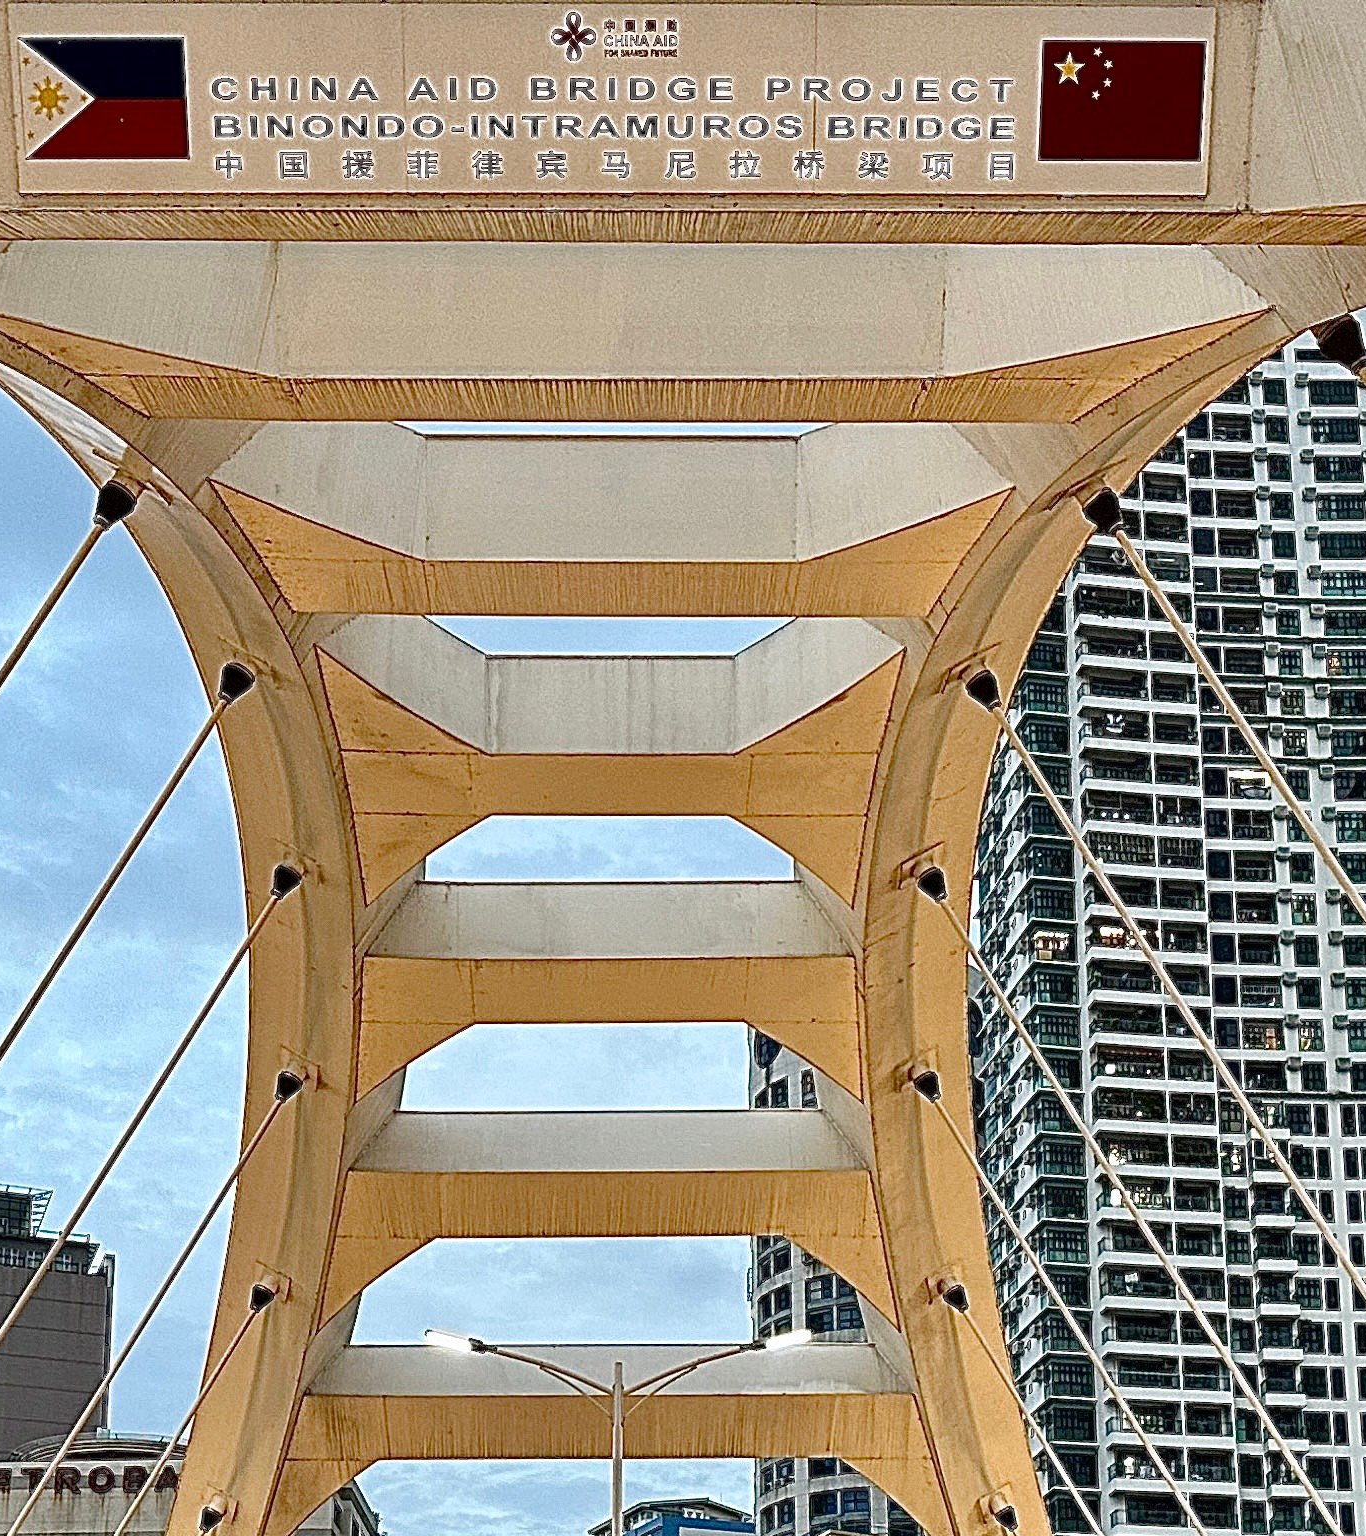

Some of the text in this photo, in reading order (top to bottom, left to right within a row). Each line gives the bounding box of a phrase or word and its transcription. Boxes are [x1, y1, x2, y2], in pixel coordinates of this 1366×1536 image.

[603, 34, 679, 48] CHINA AID
[210, 76, 1015, 102] CHINA AID BRIDGE PROJECT
[212, 114, 1016, 140] BINONDO-INTRAMUROS BRIDGE
[213, 149, 1016, 181] 中国援菲律宾马尼拉桥梁项目
